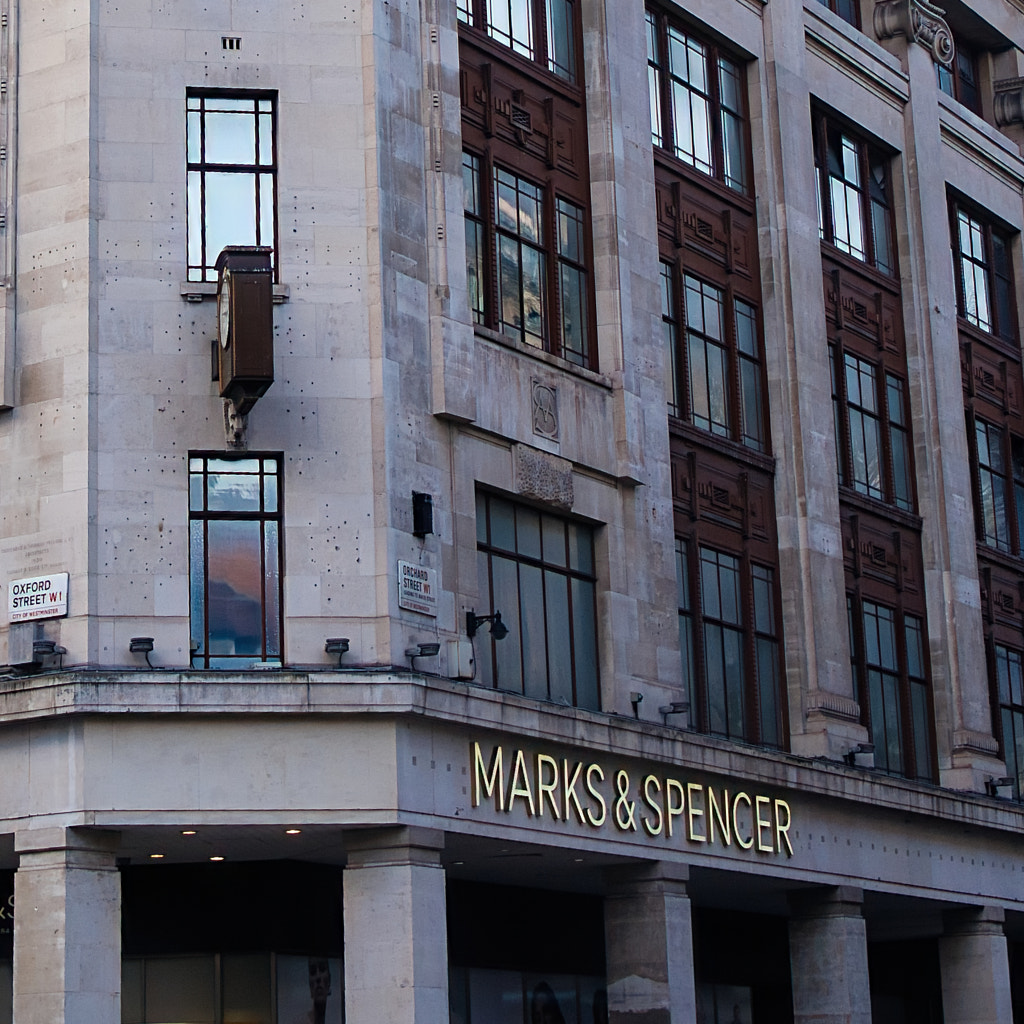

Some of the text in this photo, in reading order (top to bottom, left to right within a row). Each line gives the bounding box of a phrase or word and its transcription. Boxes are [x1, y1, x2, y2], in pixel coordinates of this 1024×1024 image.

[403, 565, 428, 581] ORCHARD
[12, 580, 51, 595] OXFORD
[403, 578, 422, 592] STREET
[12, 593, 46, 608] STREET
[29, 608, 59, 617] WESTMINSTER
[471, 741, 795, 858] MARKS & SPENCER
